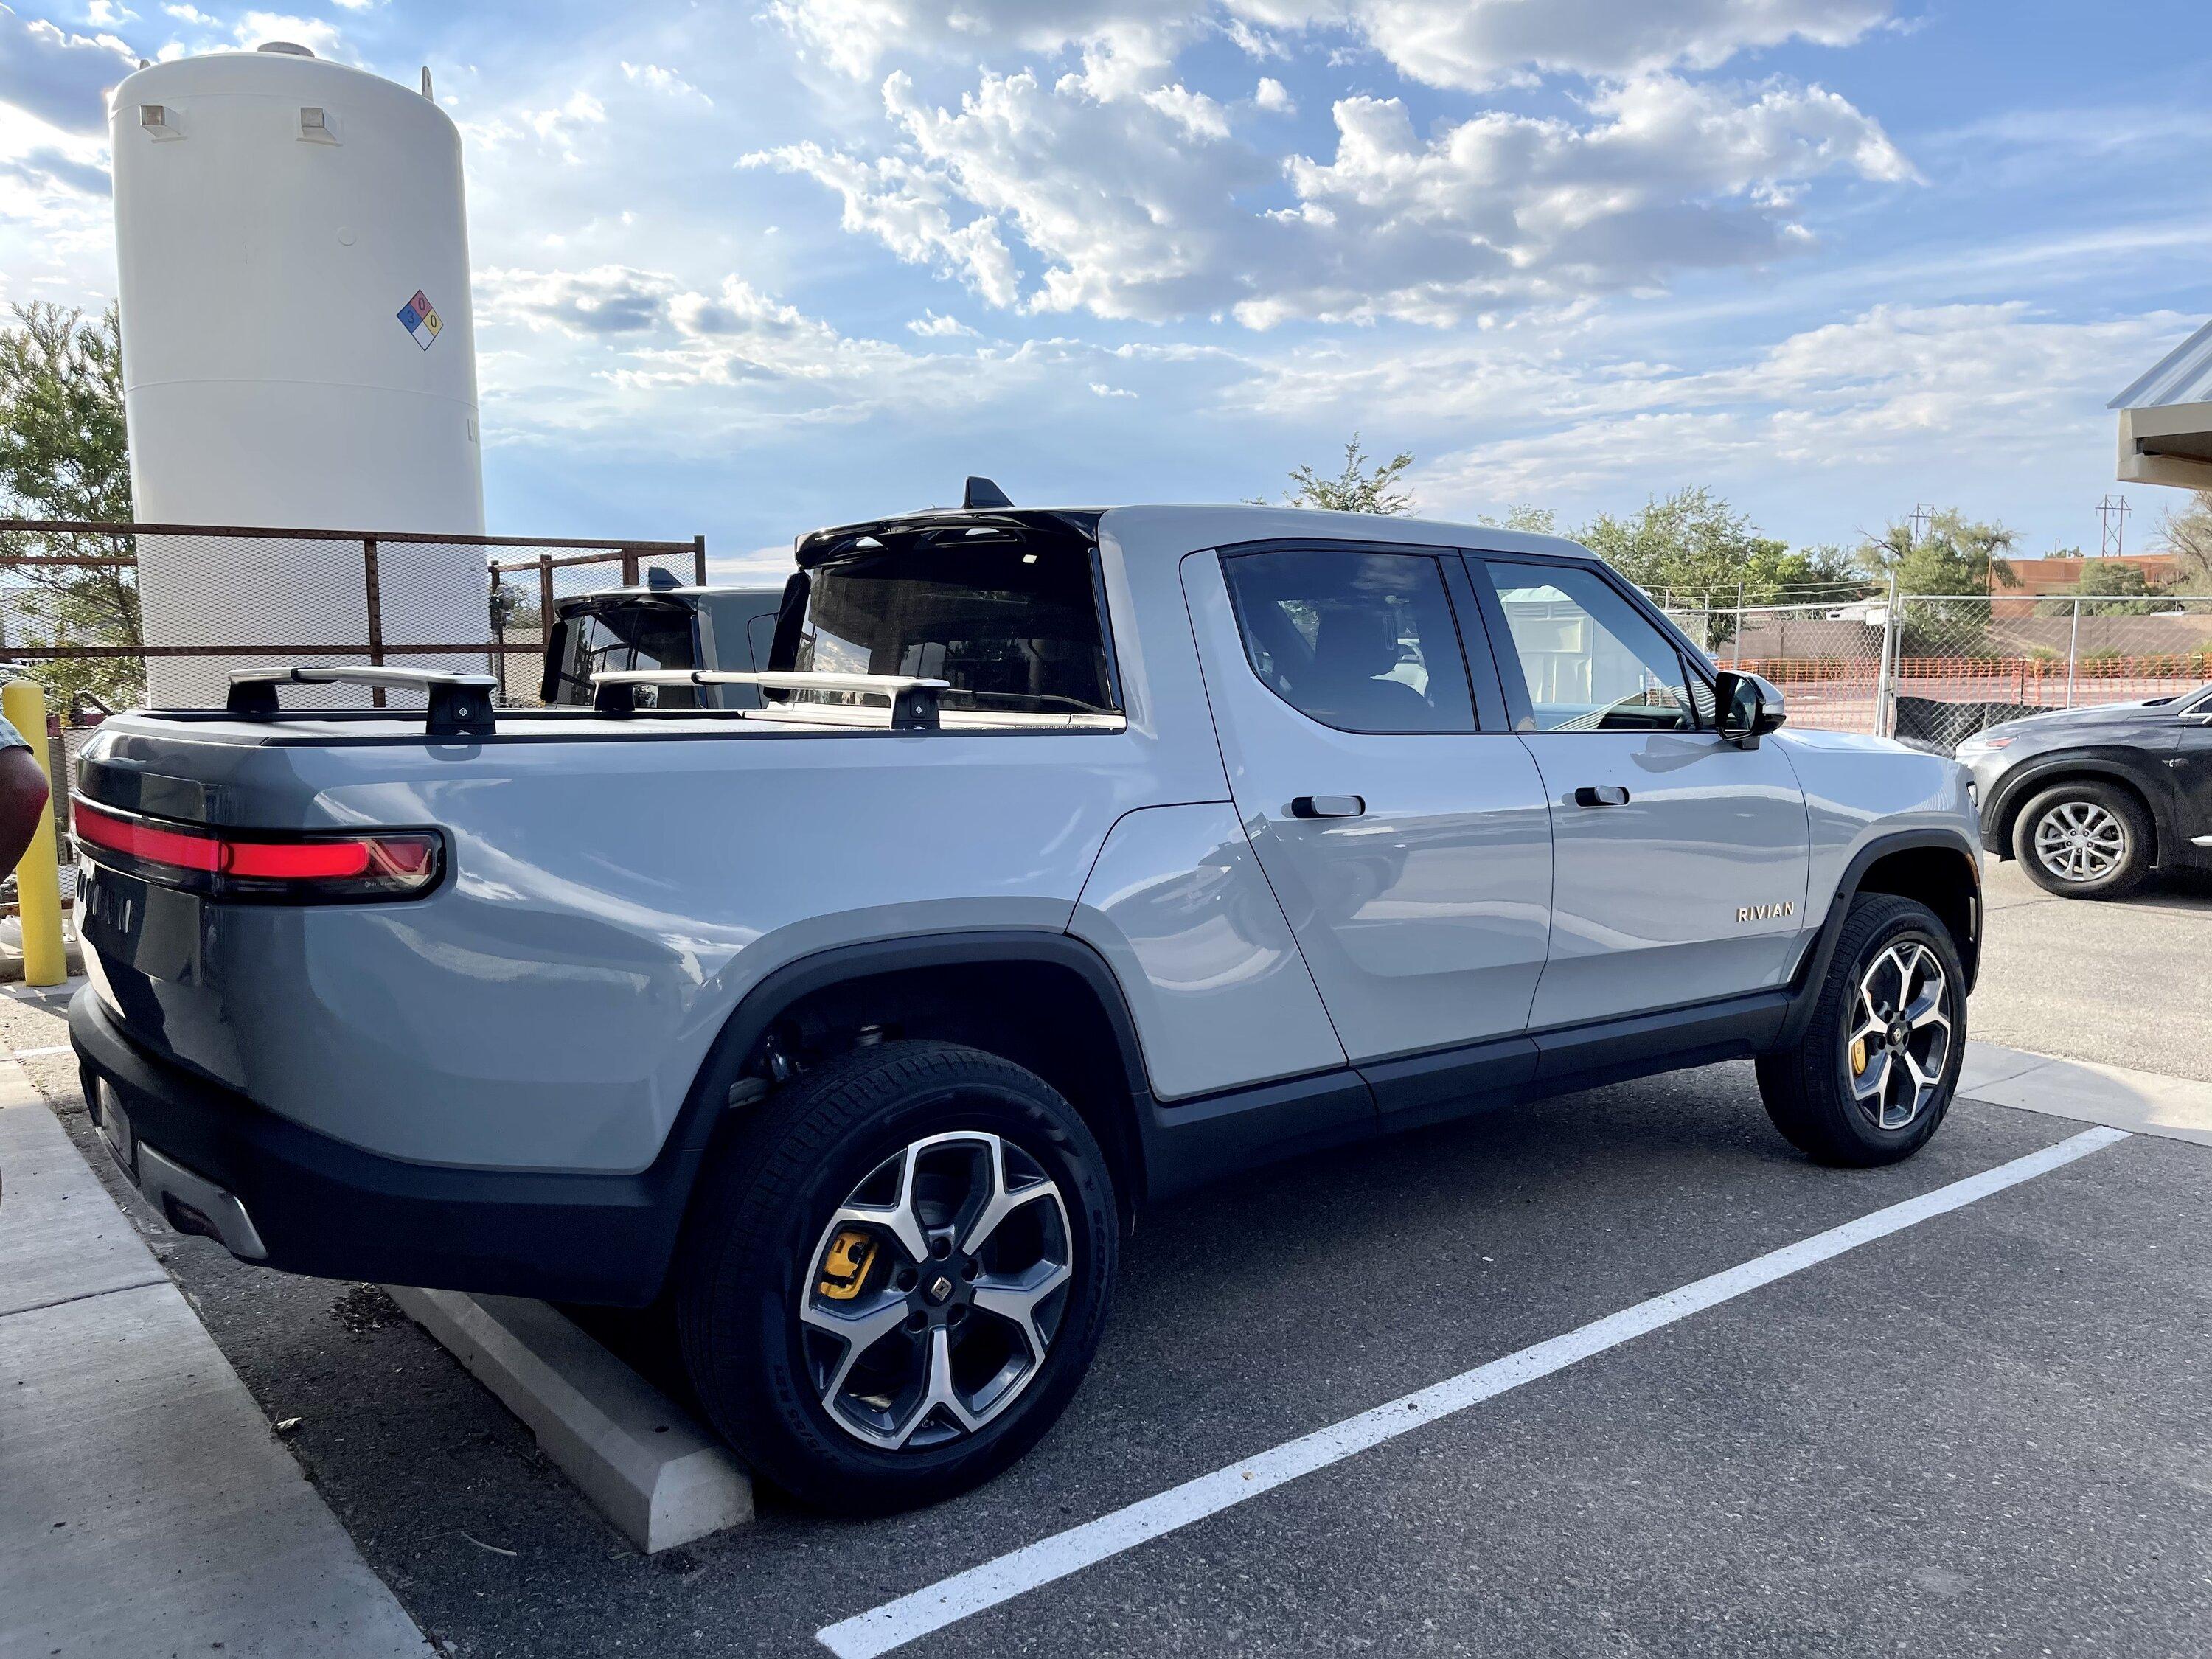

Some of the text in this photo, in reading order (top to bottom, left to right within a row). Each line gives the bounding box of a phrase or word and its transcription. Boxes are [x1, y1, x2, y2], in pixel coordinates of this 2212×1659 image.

[419, 297, 425, 310] 0
[407, 310, 414, 323] 3
[431, 314, 437, 328] 0
[1736, 901, 1795, 922] RIVIAN
